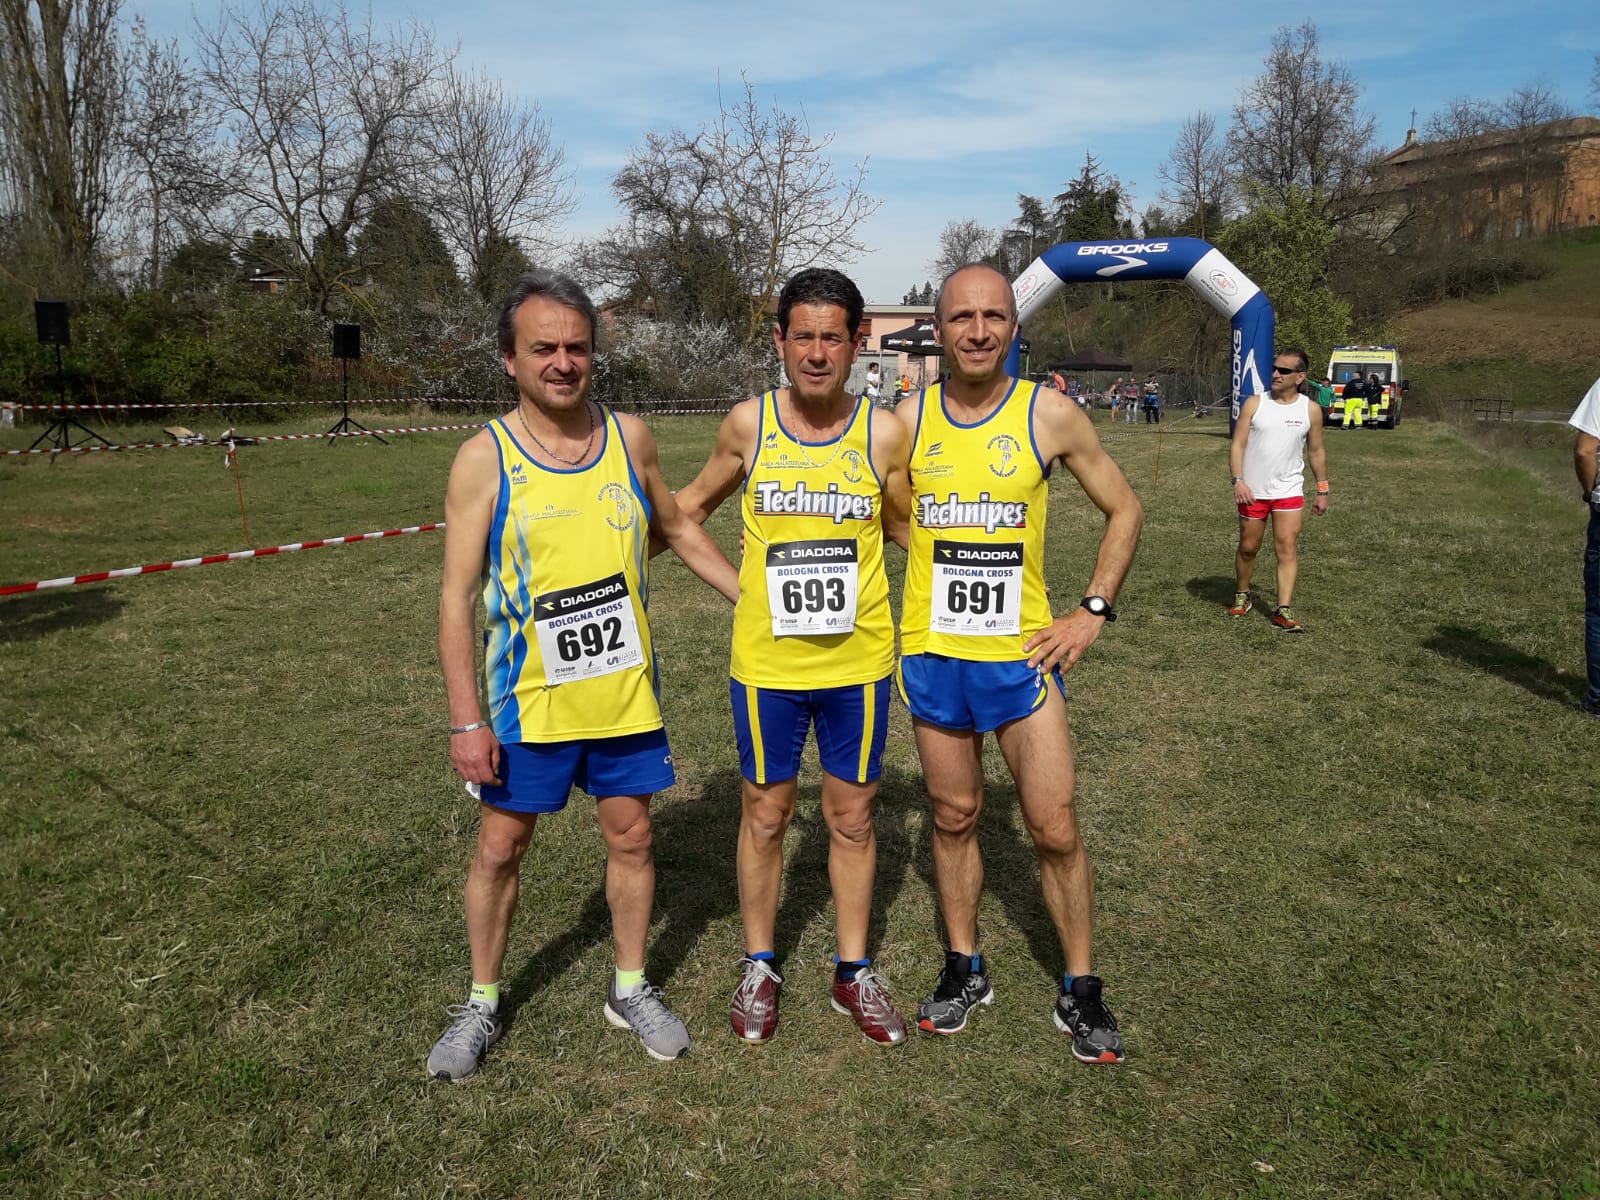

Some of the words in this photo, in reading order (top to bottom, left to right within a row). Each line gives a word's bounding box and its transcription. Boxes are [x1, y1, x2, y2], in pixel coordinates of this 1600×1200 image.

[1077, 242, 1169, 256] BROOKS
[1232, 328, 1242, 420] BROOKS
[756, 481, 872, 524] Technipes
[919, 492, 1025, 533] Technipes
[791, 547, 853, 559] DIADORA
[957, 550, 1019, 560] DIADORA
[777, 567, 820, 577] BOLOGNA
[822, 565, 849, 574] CROSS
[943, 567, 984, 578] BOLOGNA
[986, 569, 1013, 578] CROSS
[560, 582, 624, 608] DIADORA
[782, 577, 846, 614] 693
[947, 580, 1005, 615] 691
[548, 611, 594, 630] BOLOGNA
[595, 601, 623, 617] CROSS
[556, 616, 626, 662] 692
